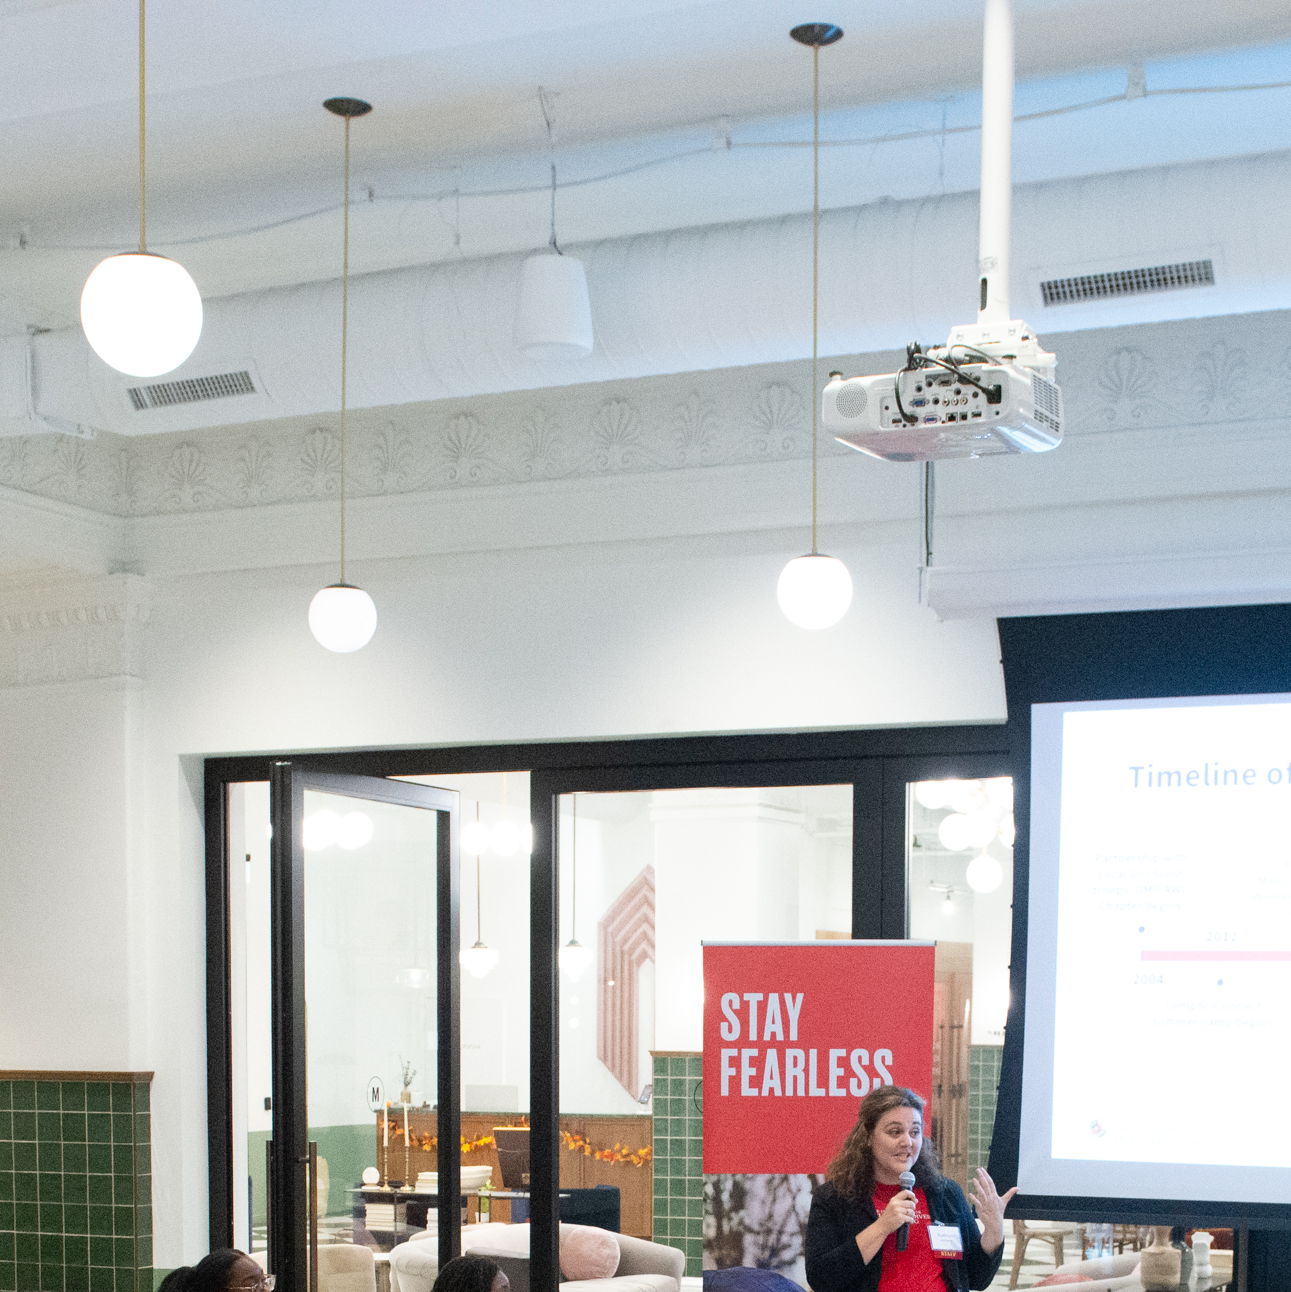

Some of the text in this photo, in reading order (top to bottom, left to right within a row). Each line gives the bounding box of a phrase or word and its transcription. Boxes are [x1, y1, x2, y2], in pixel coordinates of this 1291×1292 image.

[1127, 757, 1259, 791] Timeline
[1205, 931, 1239, 943] 2012
[1133, 974, 1165, 986] 2004
[720, 992, 804, 1042] STAY
[720, 1048, 893, 1097] FEARLESS
[372, 1086, 380, 1103] M
